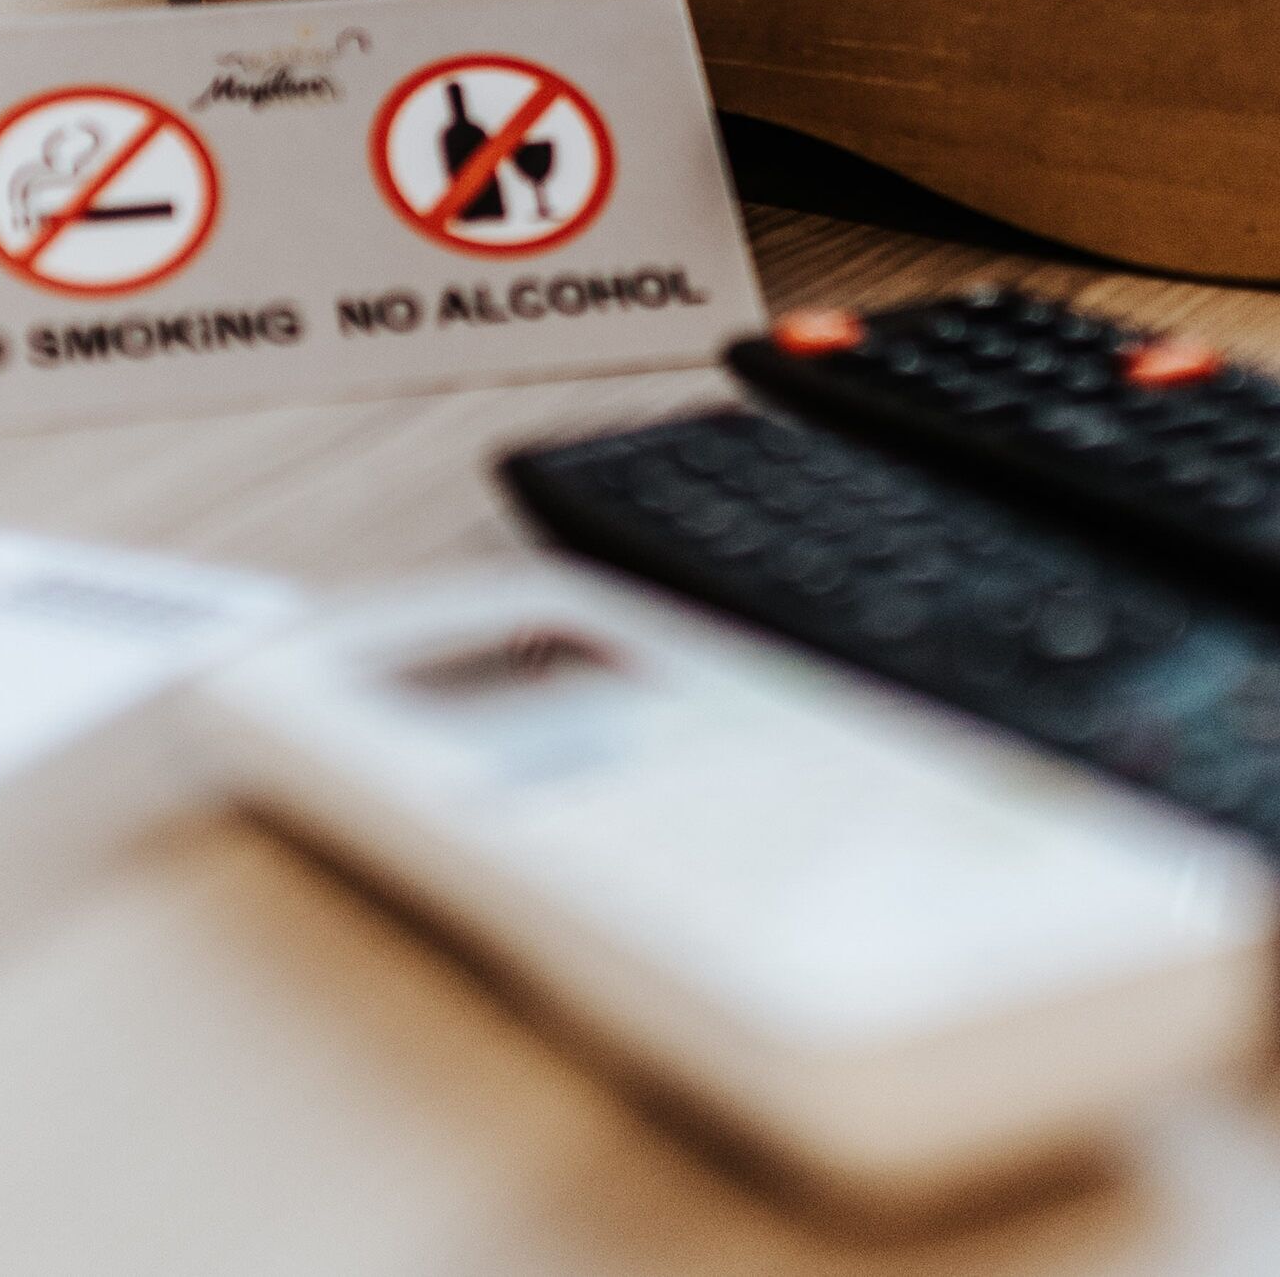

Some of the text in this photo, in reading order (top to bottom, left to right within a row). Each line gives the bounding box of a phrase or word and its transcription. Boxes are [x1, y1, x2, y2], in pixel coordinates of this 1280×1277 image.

[24, 299, 303, 367] SMOKING
[335, 263, 707, 336] NO ALCOHOL
